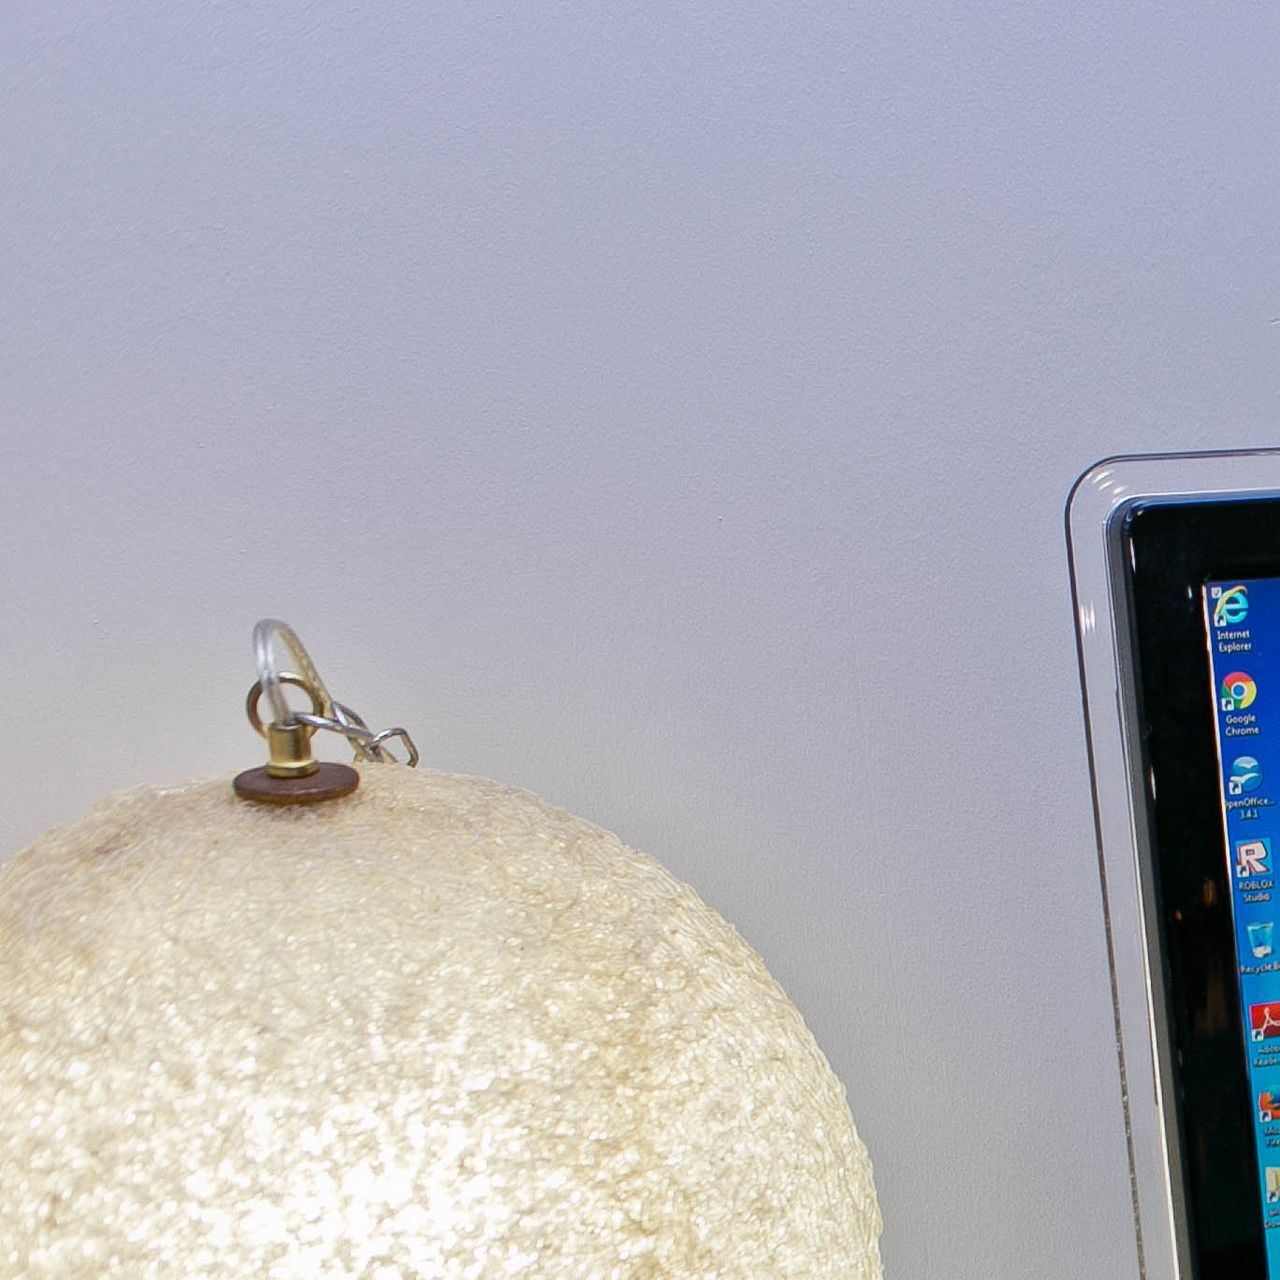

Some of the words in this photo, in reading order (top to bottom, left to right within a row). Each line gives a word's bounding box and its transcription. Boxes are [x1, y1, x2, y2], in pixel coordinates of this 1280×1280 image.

[1217, 629, 1250, 641] Internet
[1219, 642, 1252, 654] Explorer
[1226, 713, 1256, 725] Google
[1225, 725, 1260, 736] Chrome
